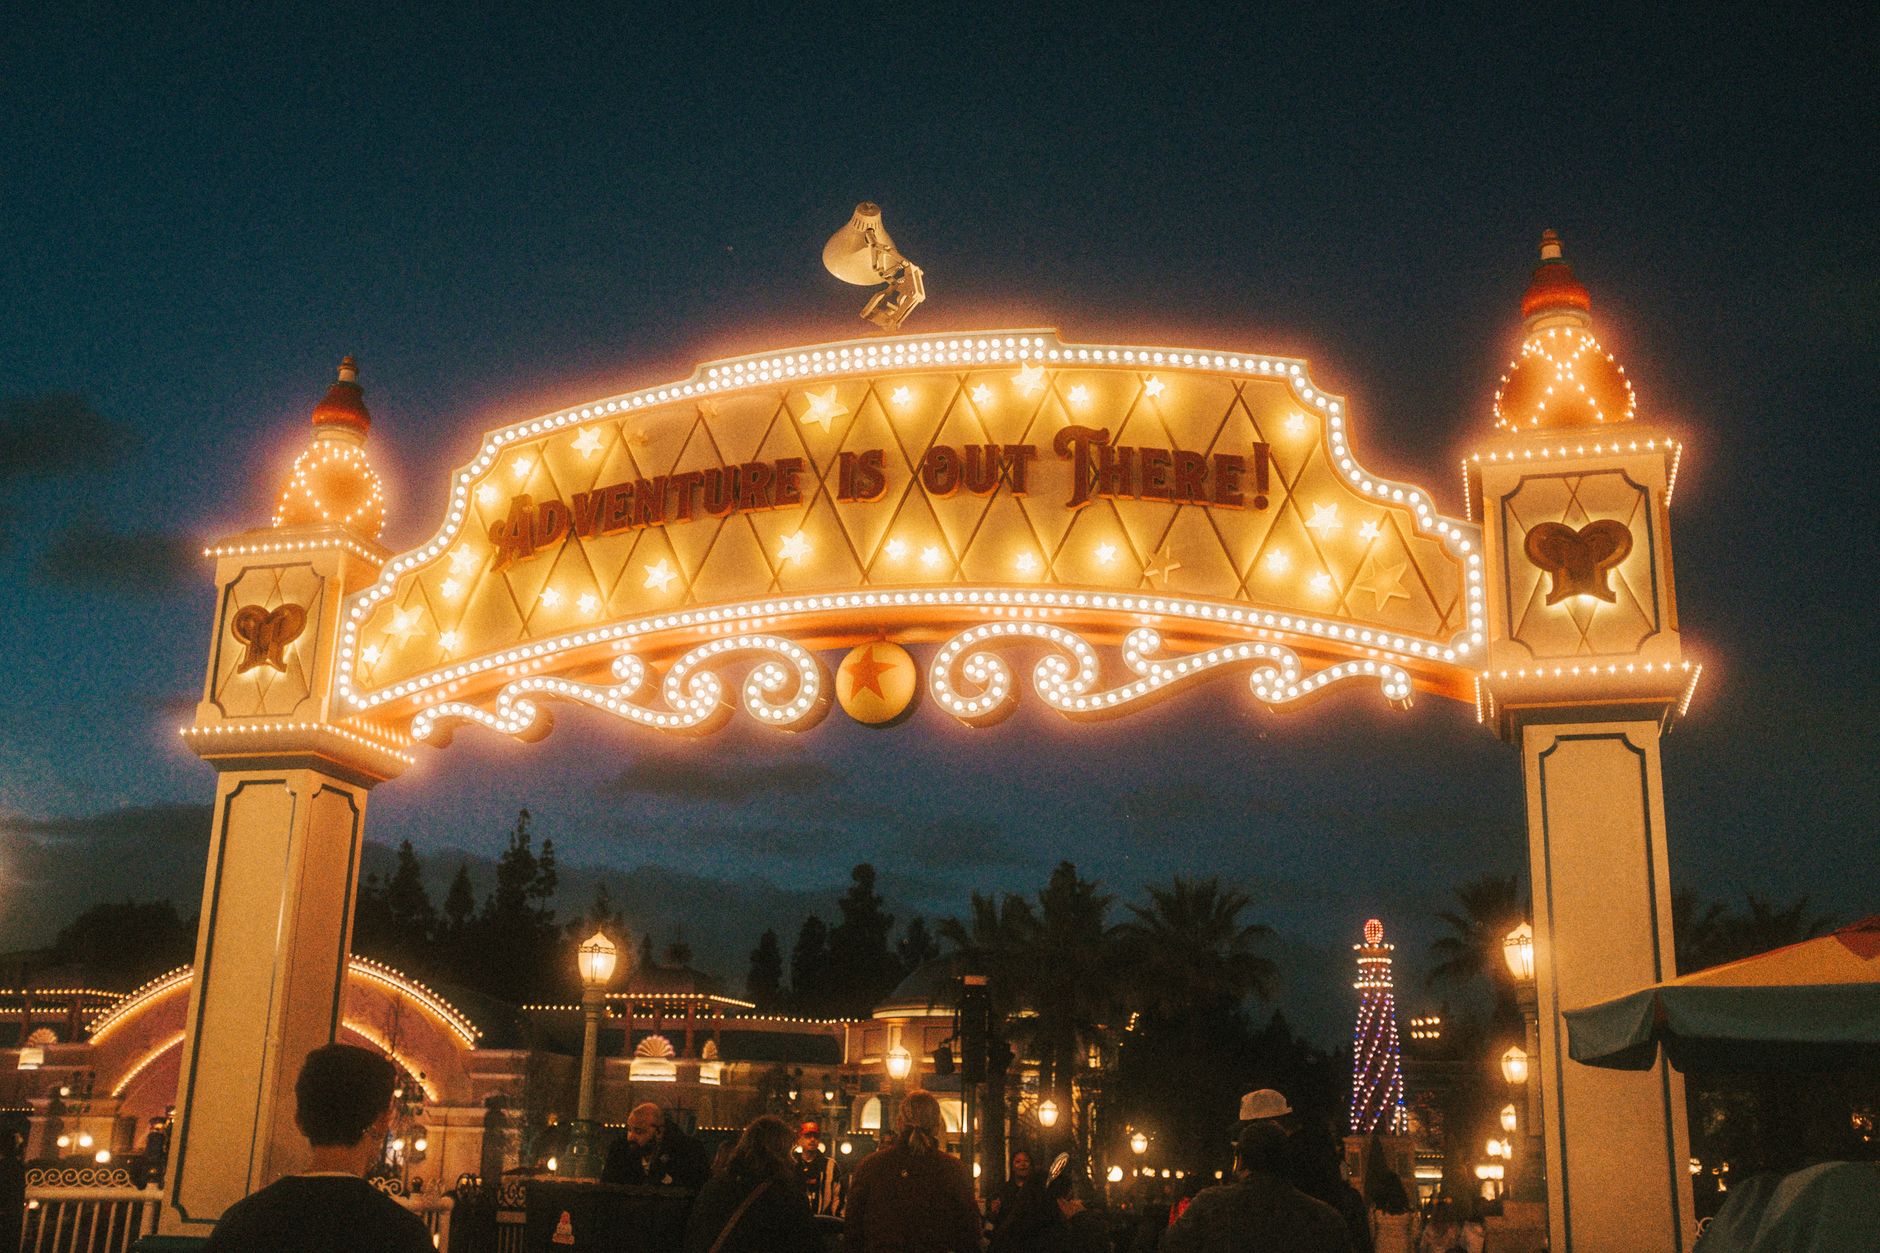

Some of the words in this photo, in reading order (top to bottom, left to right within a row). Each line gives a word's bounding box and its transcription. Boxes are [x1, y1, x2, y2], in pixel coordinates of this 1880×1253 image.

[489, 457, 804, 572] ADVENTURE
[836, 449, 888, 503] IS
[922, 444, 1037, 498] OUT
[1053, 425, 1270, 511] THERE!
